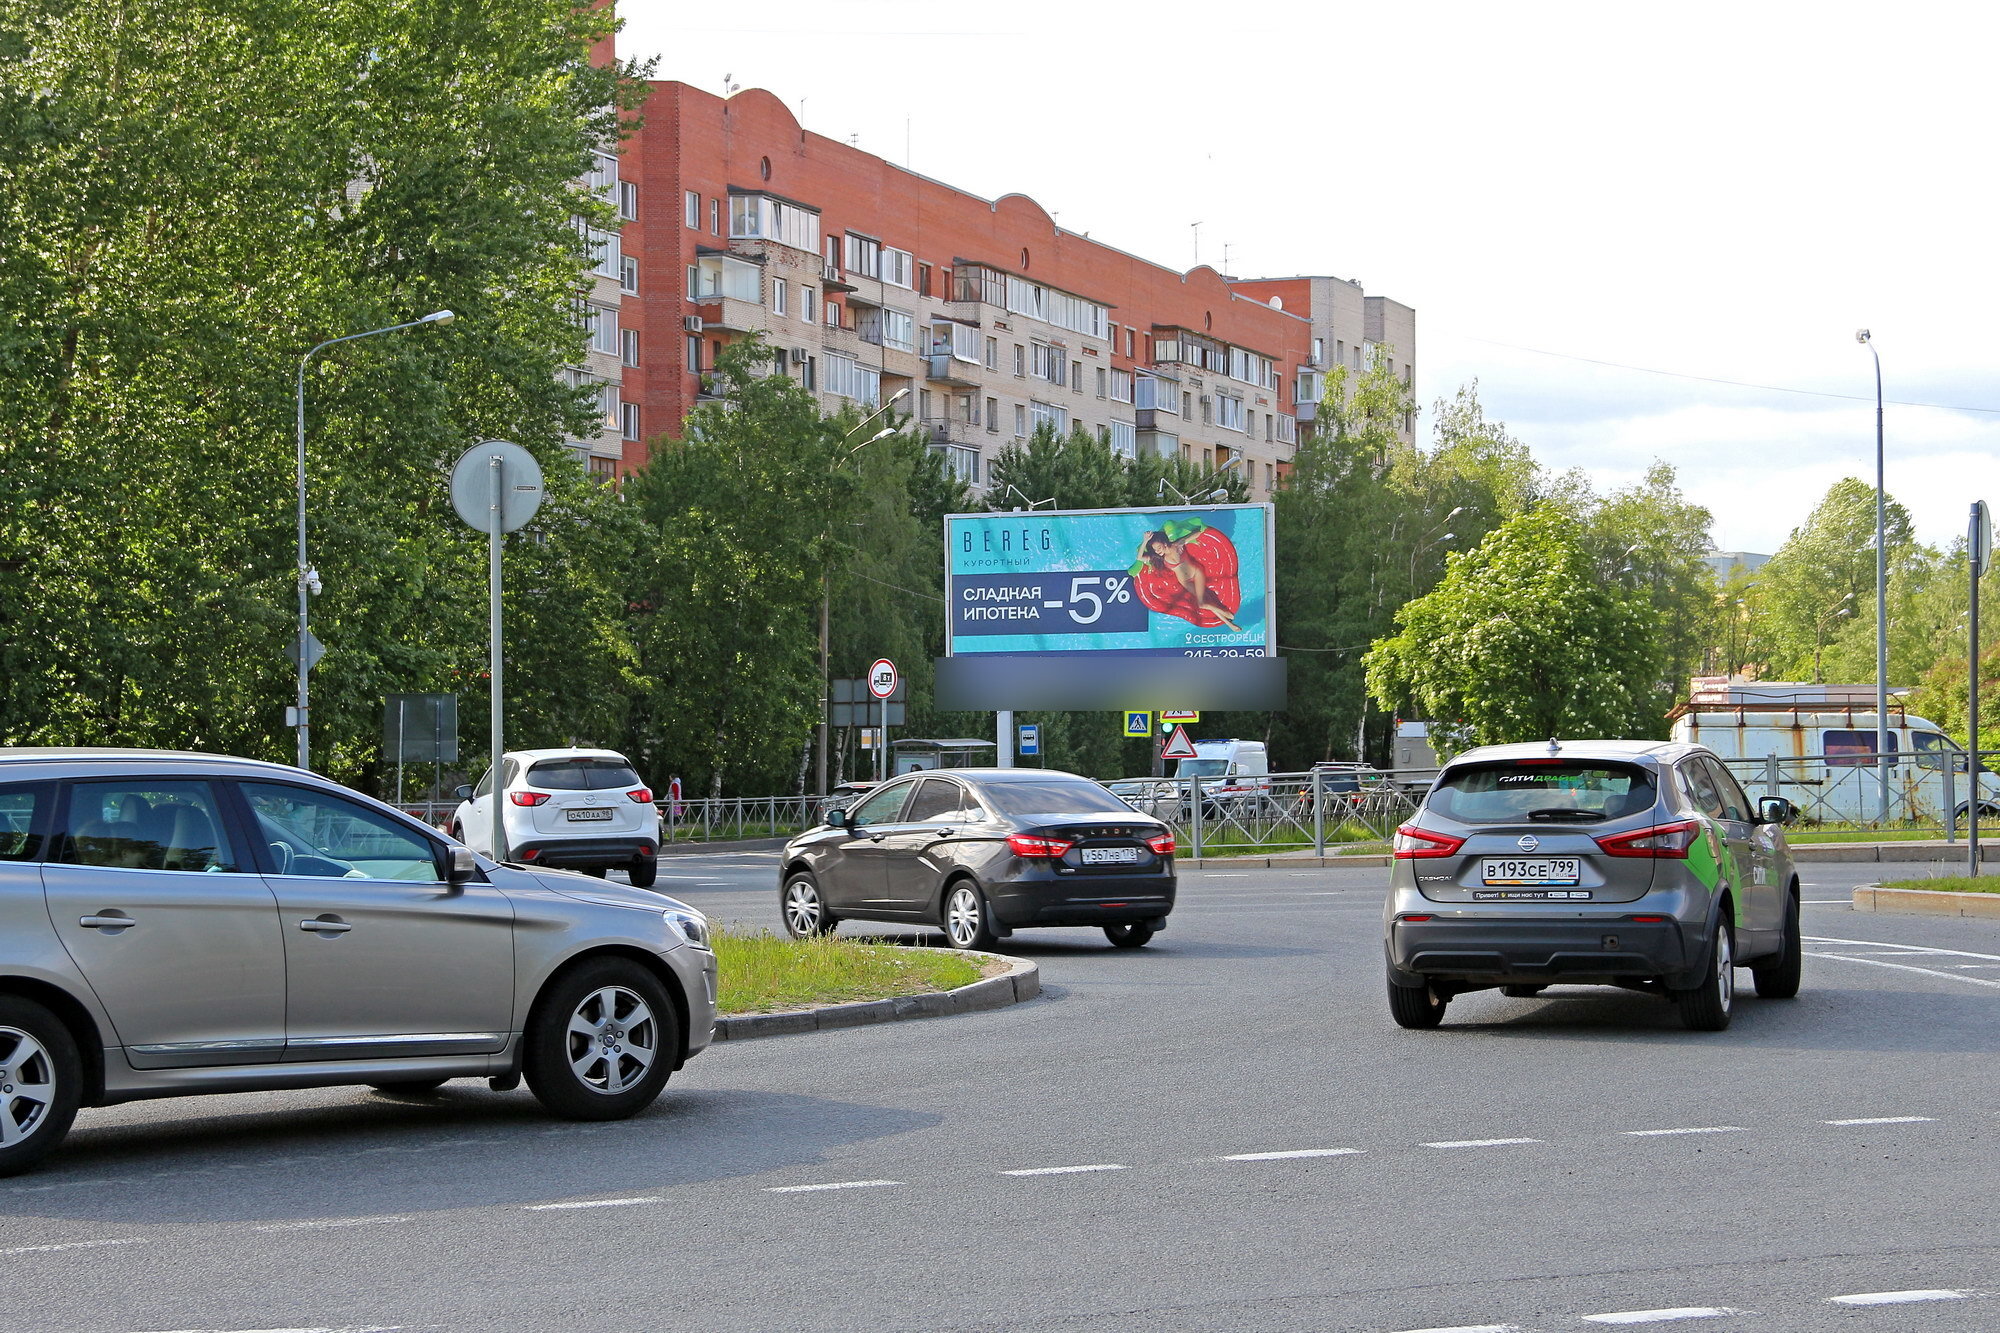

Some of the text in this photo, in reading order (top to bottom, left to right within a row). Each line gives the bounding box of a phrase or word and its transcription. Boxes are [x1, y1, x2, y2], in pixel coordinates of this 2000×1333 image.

[963, 529, 1050, 553] BEREG
[963, 557, 1030, 567] КУРОРТНЫЙ
[963, 586, 1042, 602] СЛАДКАЯ
[963, 606, 1041, 621] ИПОТЕКА
[1487, 860, 1574, 878] В193СЕ 799
